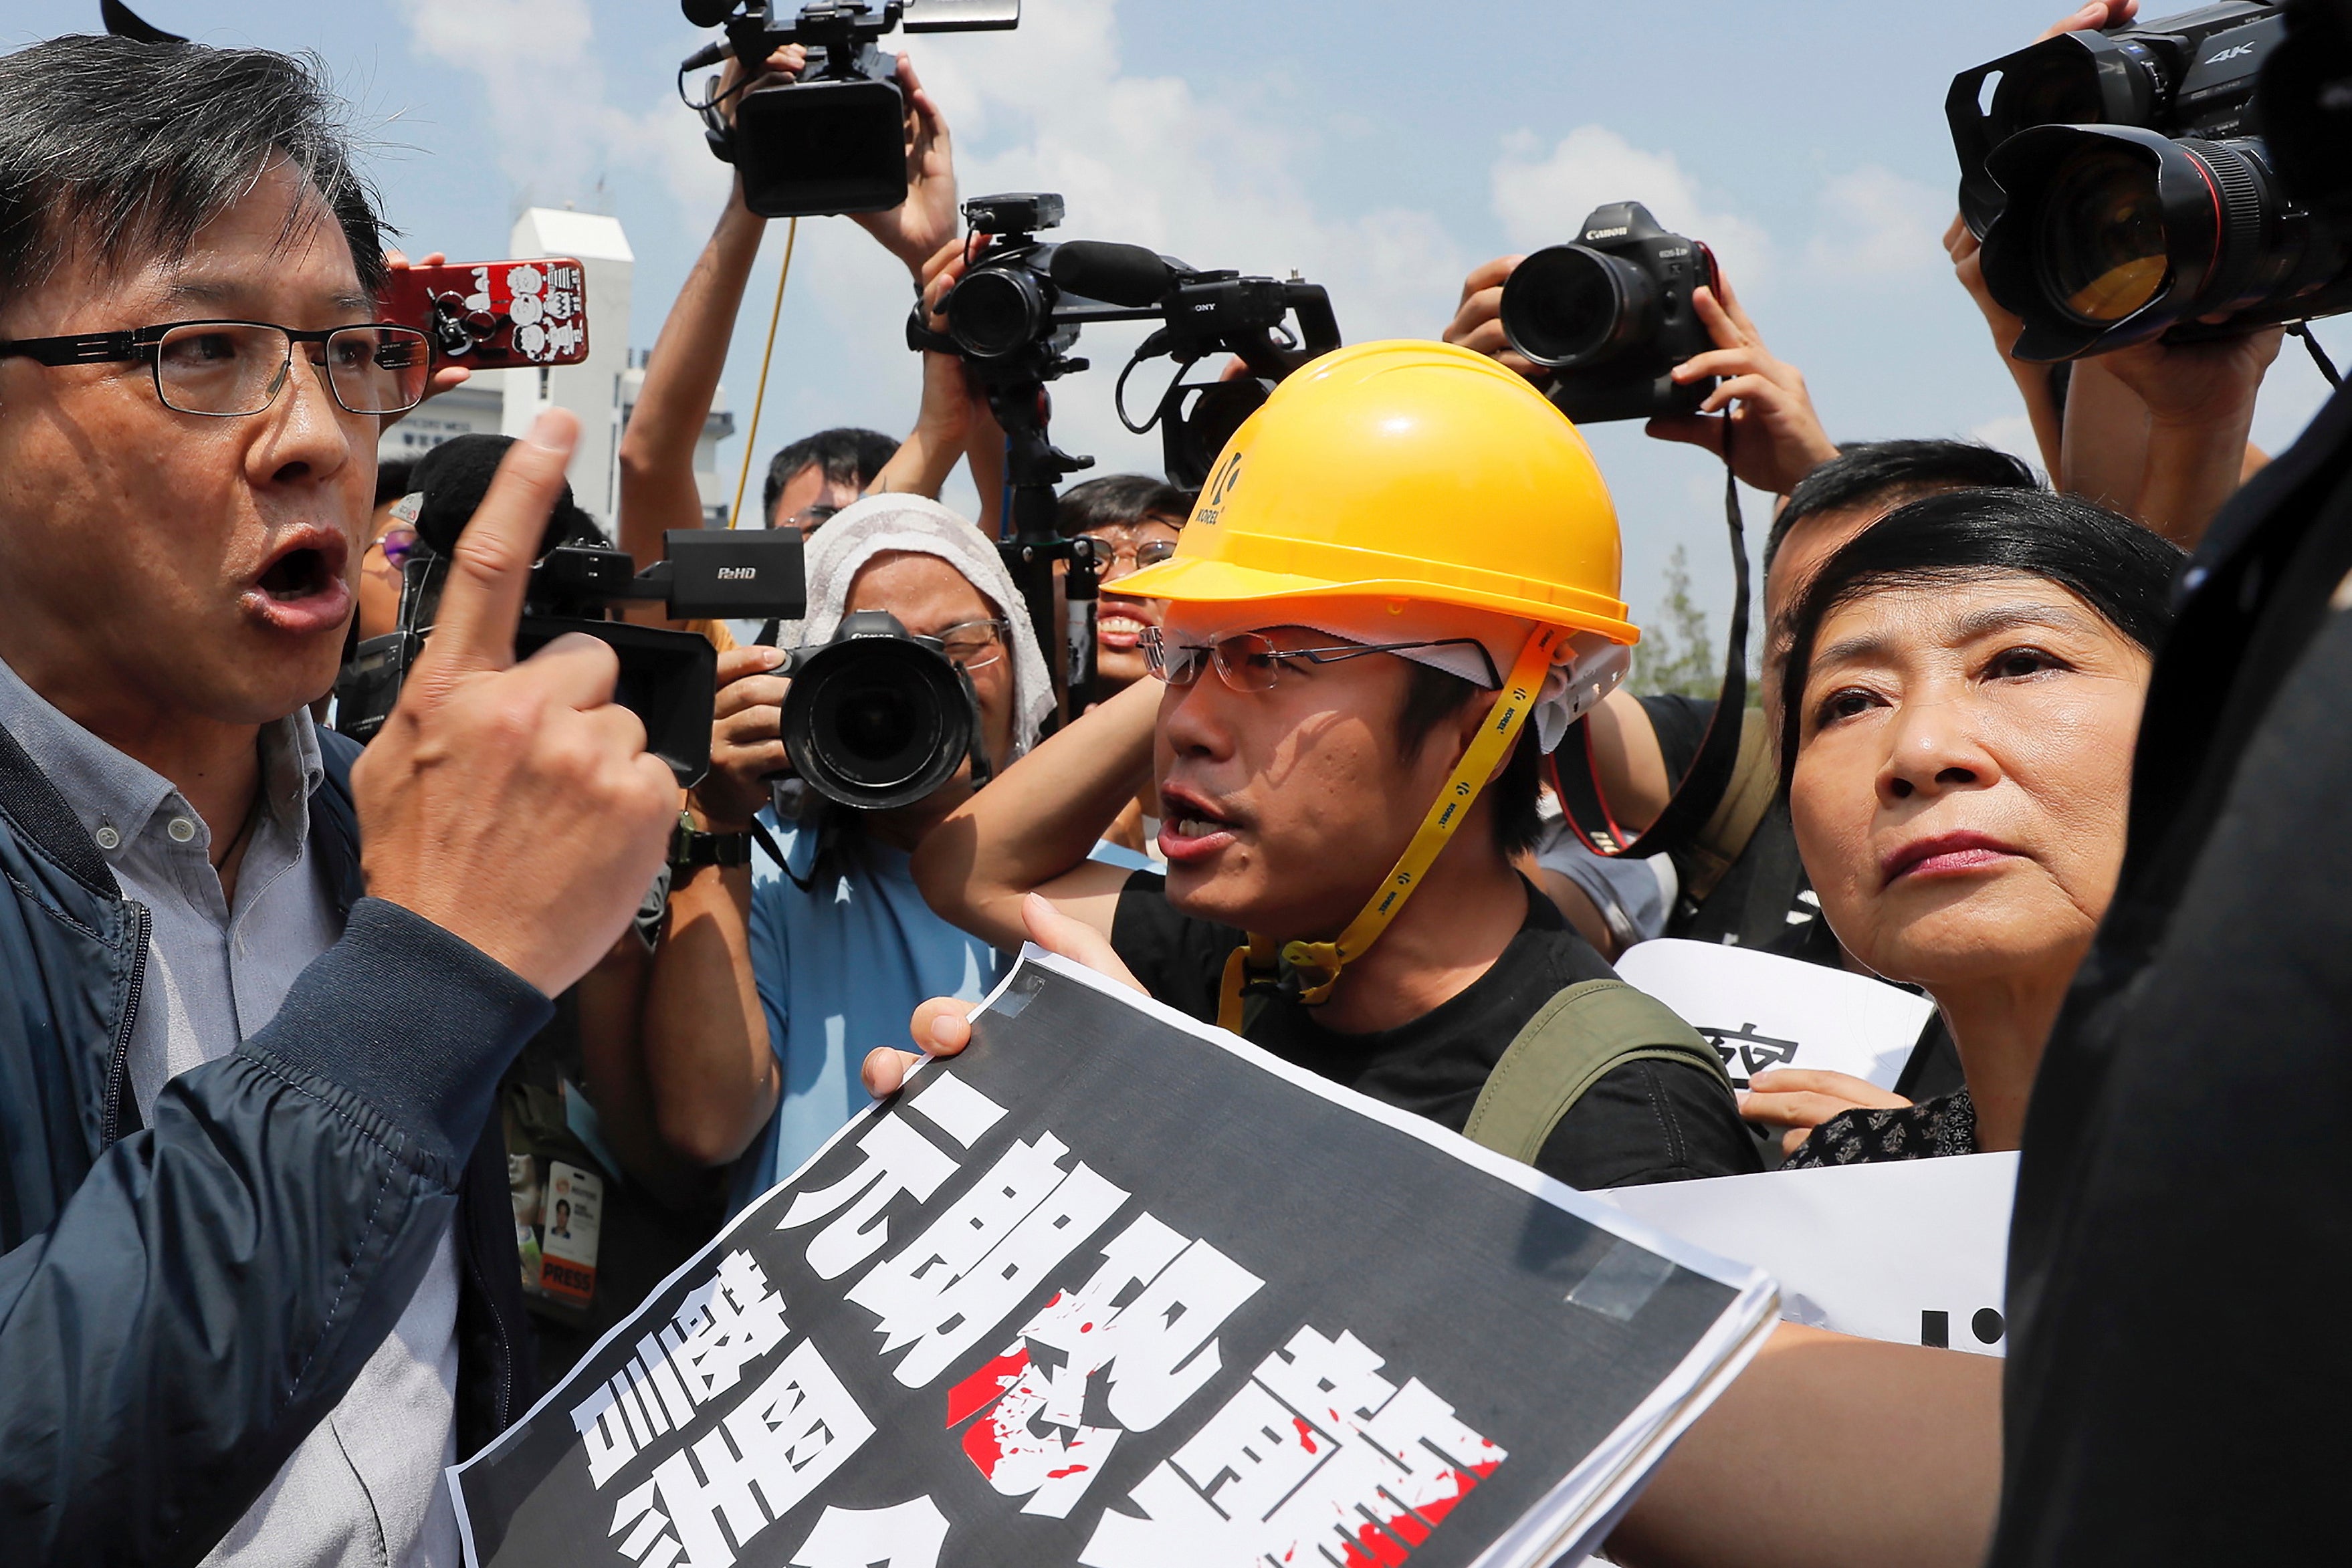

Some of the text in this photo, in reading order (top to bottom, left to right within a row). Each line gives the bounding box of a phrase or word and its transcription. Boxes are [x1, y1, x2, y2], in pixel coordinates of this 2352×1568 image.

[2205, 40, 2256, 65] 4K
[1586, 227, 1628, 241] Canon
[1193, 303, 1216, 312] ONY
[1196, 509, 1219, 525] KOREL
[1497, 707, 1515, 731] KOREL
[1438, 802, 1457, 825] KOREL
[1378, 891, 1398, 913] KOREL
[544, 1263, 591, 1291] PRESS
[776, 1070, 1509, 1568] 元朗恐襲
